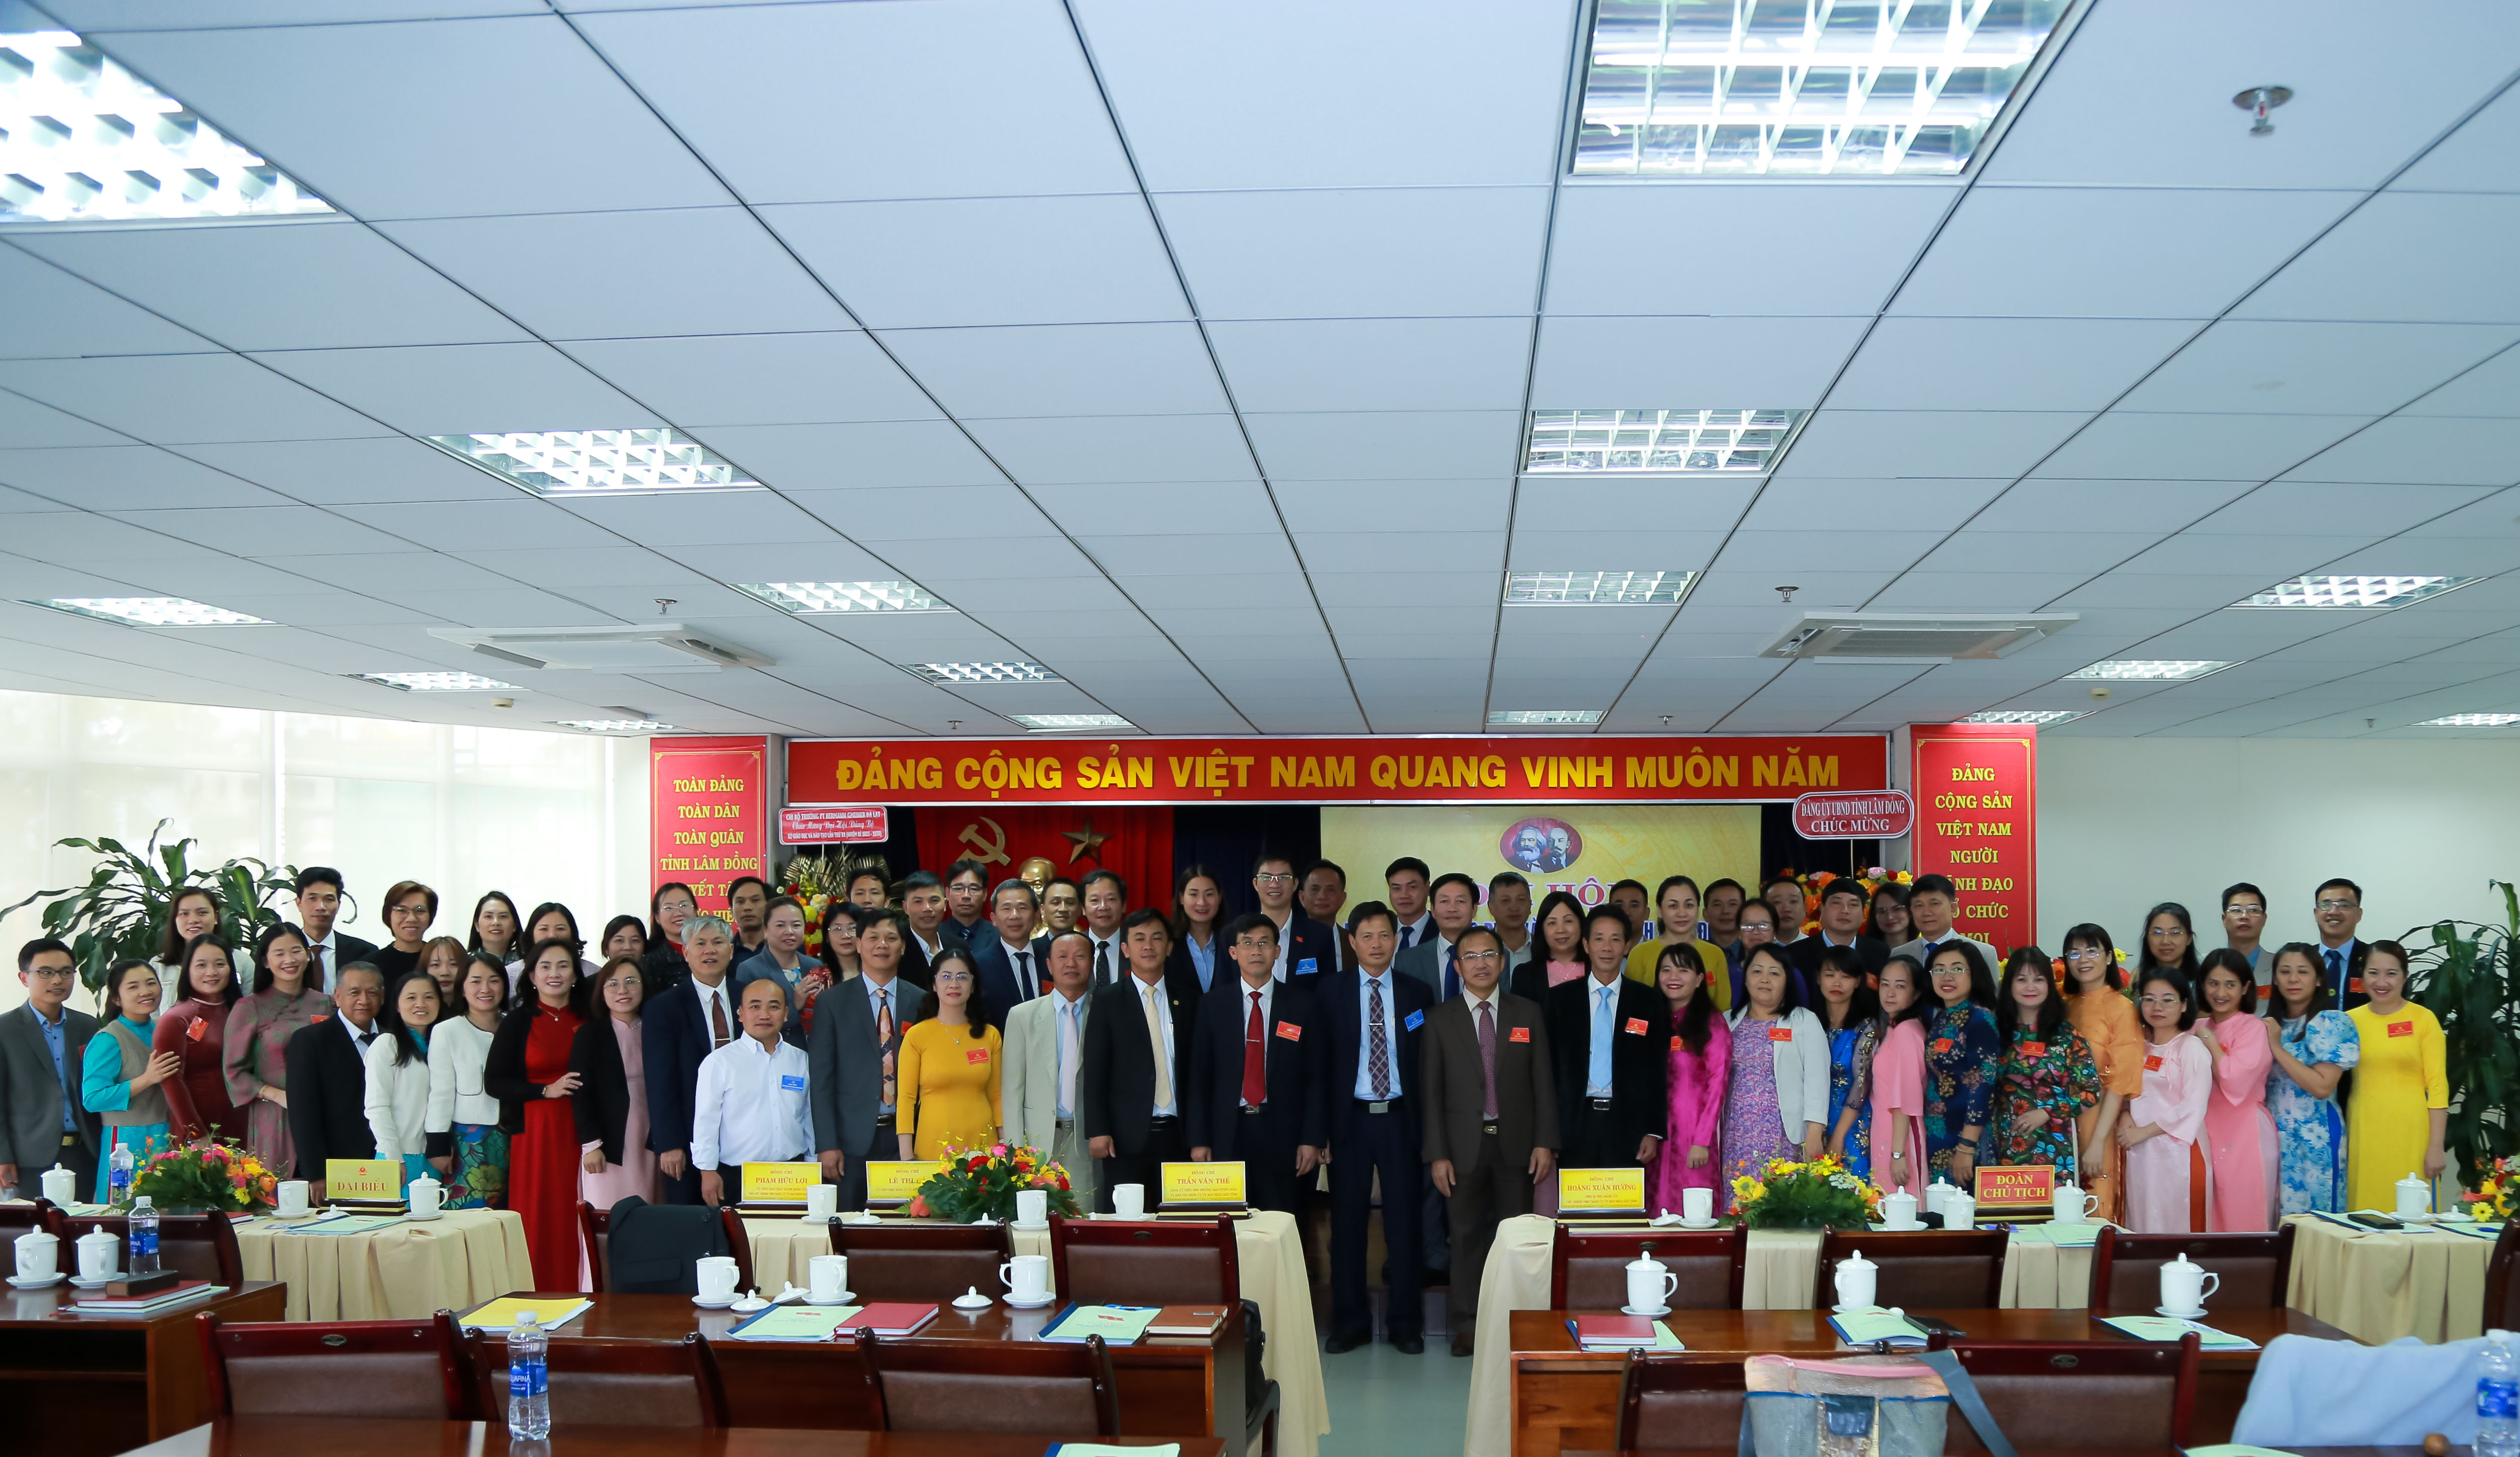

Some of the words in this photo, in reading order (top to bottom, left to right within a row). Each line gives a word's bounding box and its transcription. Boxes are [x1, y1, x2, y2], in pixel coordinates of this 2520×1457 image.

[836, 746, 943, 790] ĐẢNG
[955, 749, 1062, 798] CỘNG
[1076, 744, 1153, 789] SẢN
[1168, 748, 1255, 797] VIỆT
[1271, 756, 1356, 788] NAM
[1370, 755, 1506, 790] QUANG
[1521, 756, 1613, 788] VINH
[1625, 746, 1739, 788] MUÔN
[1753, 746, 1839, 786] NĂM
[1952, 763, 1995, 781] ĐẢNG
[673, 775, 706, 792] TOÀN
[709, 774, 744, 792] ĐẢNG
[1801, 799, 1821, 816] ĐẢNG
[1822, 798, 1831, 816] ỦY
[1832, 802, 1850, 815] UBND
[1851, 797, 1867, 815] TỈNH
[1869, 797, 1884, 815] LÂM
[1885, 796, 1905, 814] ĐỒNG
[1935, 791, 1978, 812] CỘNG
[1982, 790, 2013, 808] SẢN
[677, 802, 711, 819] TOÀN
[714, 802, 740, 818] DÂN
[794, 813, 801, 821] BỘ
[801, 813, 819, 821] TRƯỜNG
[1811, 817, 1848, 832] CHÚC
[1850, 816, 1889, 832] MỪNG
[1936, 819, 1973, 839] VIỆT
[1978, 823, 2012, 836] NAM
[673, 828, 706, 845] TOÀN
[710, 828, 744, 848] QUÂN
[660, 853, 690, 871] TỈNH
[693, 854, 720, 870] LÂM
[723, 850, 758, 870] ĐỒNG
[1950, 846, 1998, 863] NGƯỜI
[1982, 877, 2013, 894] ĐẠO
[1966, 901, 2009, 918] CHỨC
[337, 1182, 358, 1193] ĐẠI
[361, 1178, 389, 1192] BIỂU
[1177, 1176, 1197, 1184] TRẦN
[1216, 1176, 1230, 1184] THẾ
[1996, 1172, 2033, 1185] ĐOÀN
[1983, 1185, 2011, 1198] CHỦ
[2014, 1187, 2046, 1200] TỊCH
